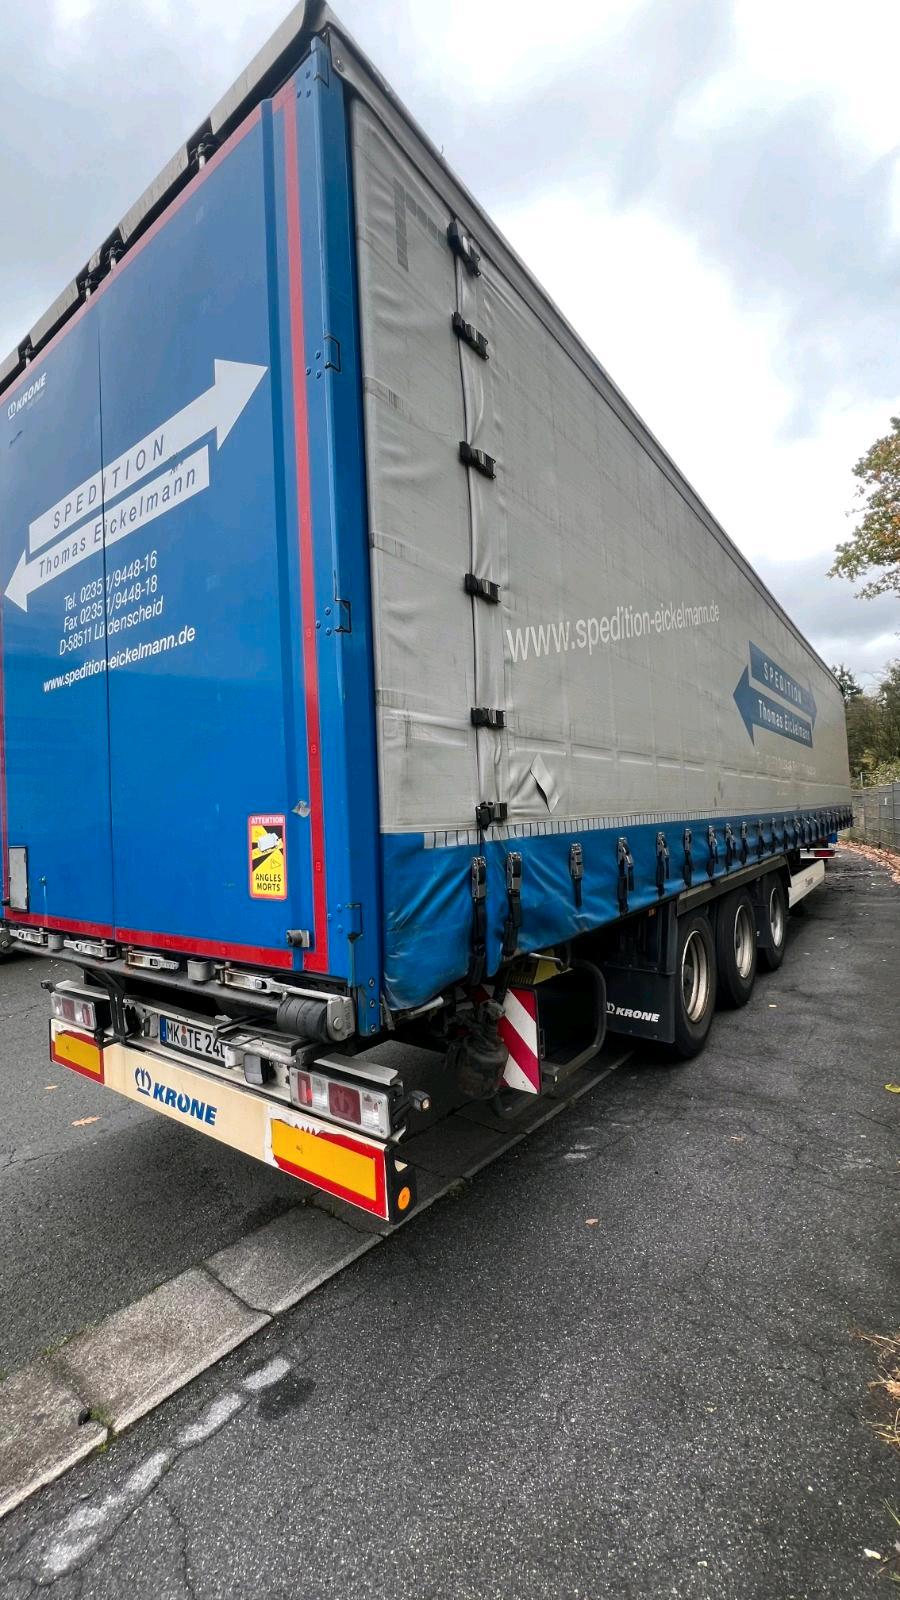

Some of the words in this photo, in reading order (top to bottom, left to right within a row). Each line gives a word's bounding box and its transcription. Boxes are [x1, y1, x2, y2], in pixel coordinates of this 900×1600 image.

[16, 372, 47, 413] KRONE
[52, 434, 165, 530] SPEDITION
[39, 536, 87, 578] Thomas
[93, 468, 196, 544] Eickelmann
[64, 592, 77, 613] Tel.
[80, 550, 158, 603] 02351/9448-16
[59, 627, 92, 656] D-58511
[94, 594, 164, 641] Lüdenscheid
[63, 613, 78, 633] Fax
[80, 574, 158, 625] 02351/9448-18
[43, 625, 196, 693] www.spedition-eickelmann.de
[763, 662, 802, 705] SPEDITION
[758, 699, 783, 729] Thomas
[251, 816, 285, 825] ATTENTION
[255, 873, 282, 882] ANGLES
[256, 883, 281, 892] MORTS
[615, 1007, 660, 1022] KRONE
[167, 1021, 180, 1044] MK
[186, 1028, 202, 1052] TE
[153, 1083, 218, 1126] KRONE
